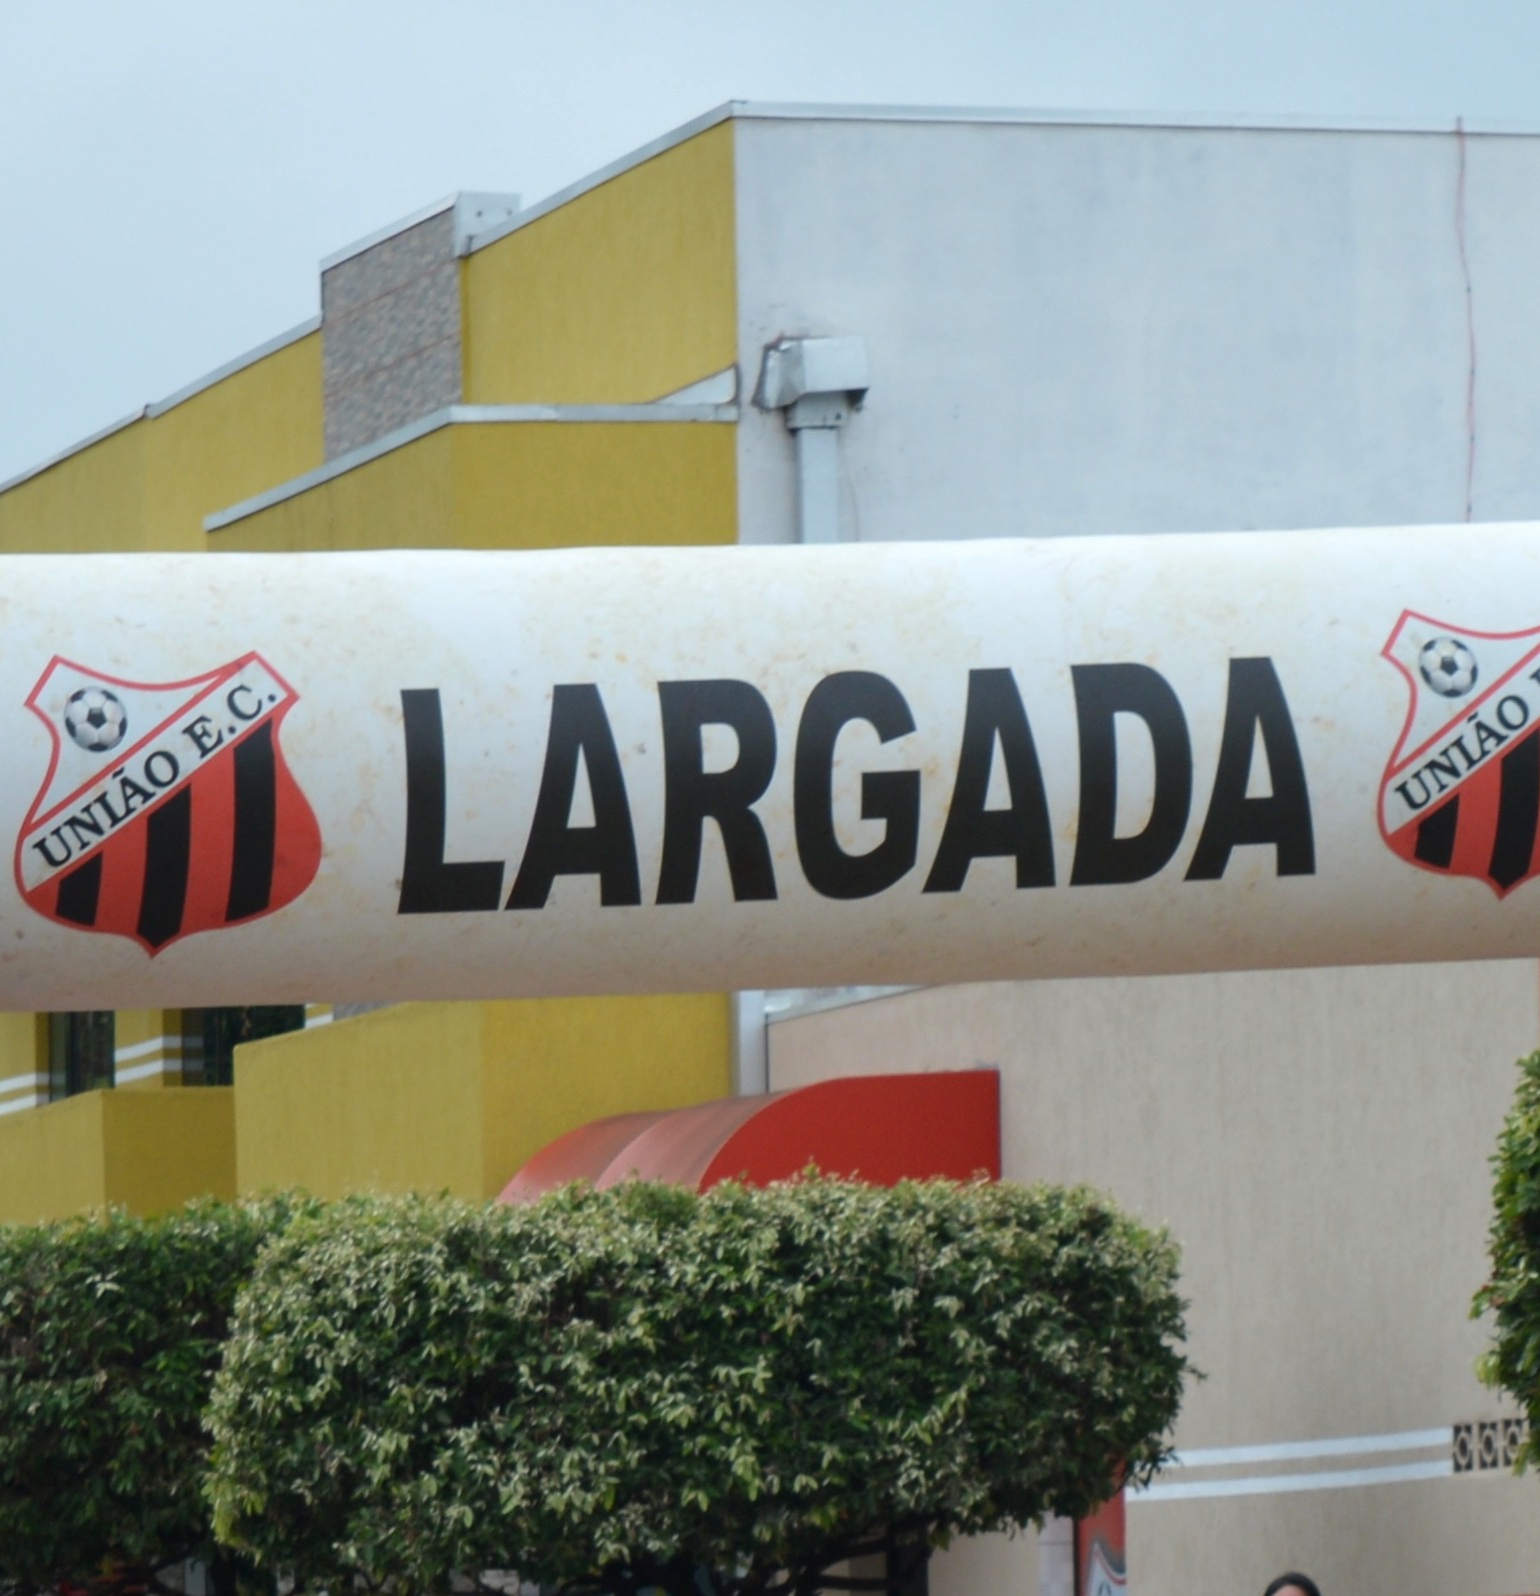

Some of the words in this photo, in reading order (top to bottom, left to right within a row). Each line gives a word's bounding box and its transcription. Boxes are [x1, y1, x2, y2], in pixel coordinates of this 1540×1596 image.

[31, 748, 182, 872] UNIÃO
[182, 680, 280, 762] E.C.
[397, 656, 1317, 915] LARGADA
[1393, 692, 1531, 812] UNIÃO
